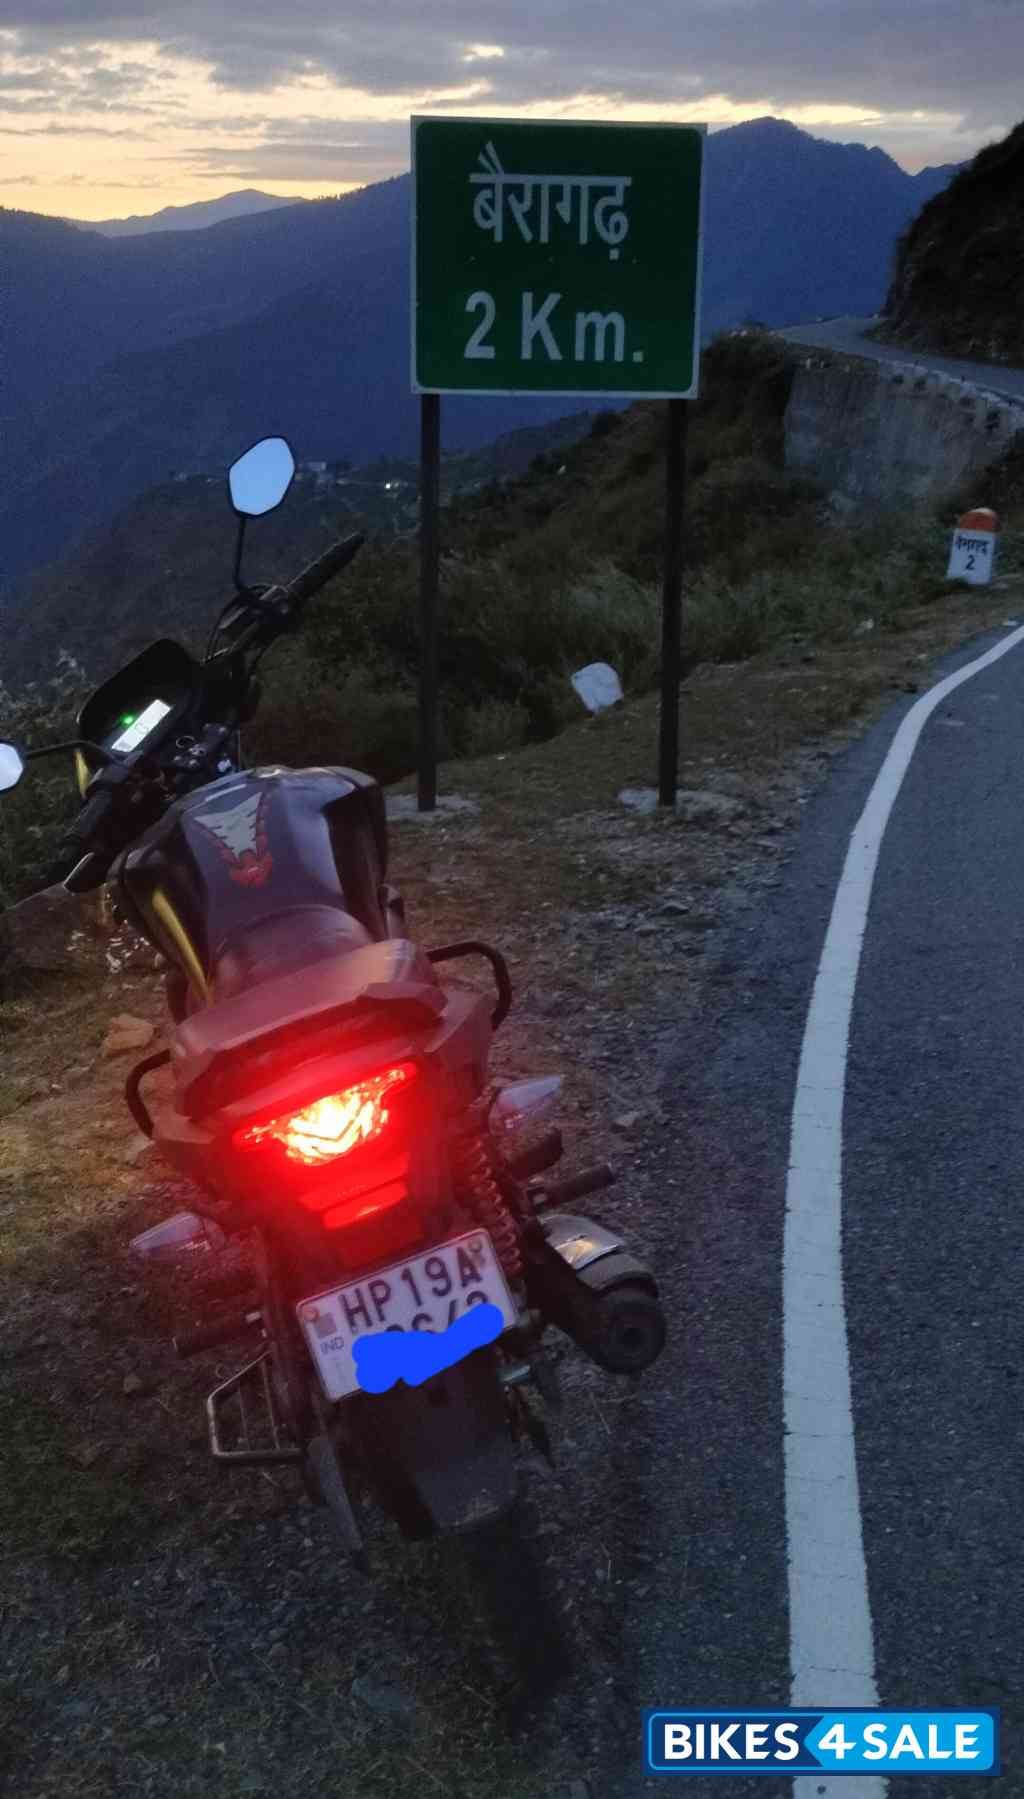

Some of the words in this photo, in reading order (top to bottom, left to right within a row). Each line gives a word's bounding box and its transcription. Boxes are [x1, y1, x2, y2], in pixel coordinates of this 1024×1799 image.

[469, 140, 632, 260] बैरागढ़
[463, 290, 497, 360] 2
[520, 291, 644, 363] Km.
[965, 554, 977, 571] 2
